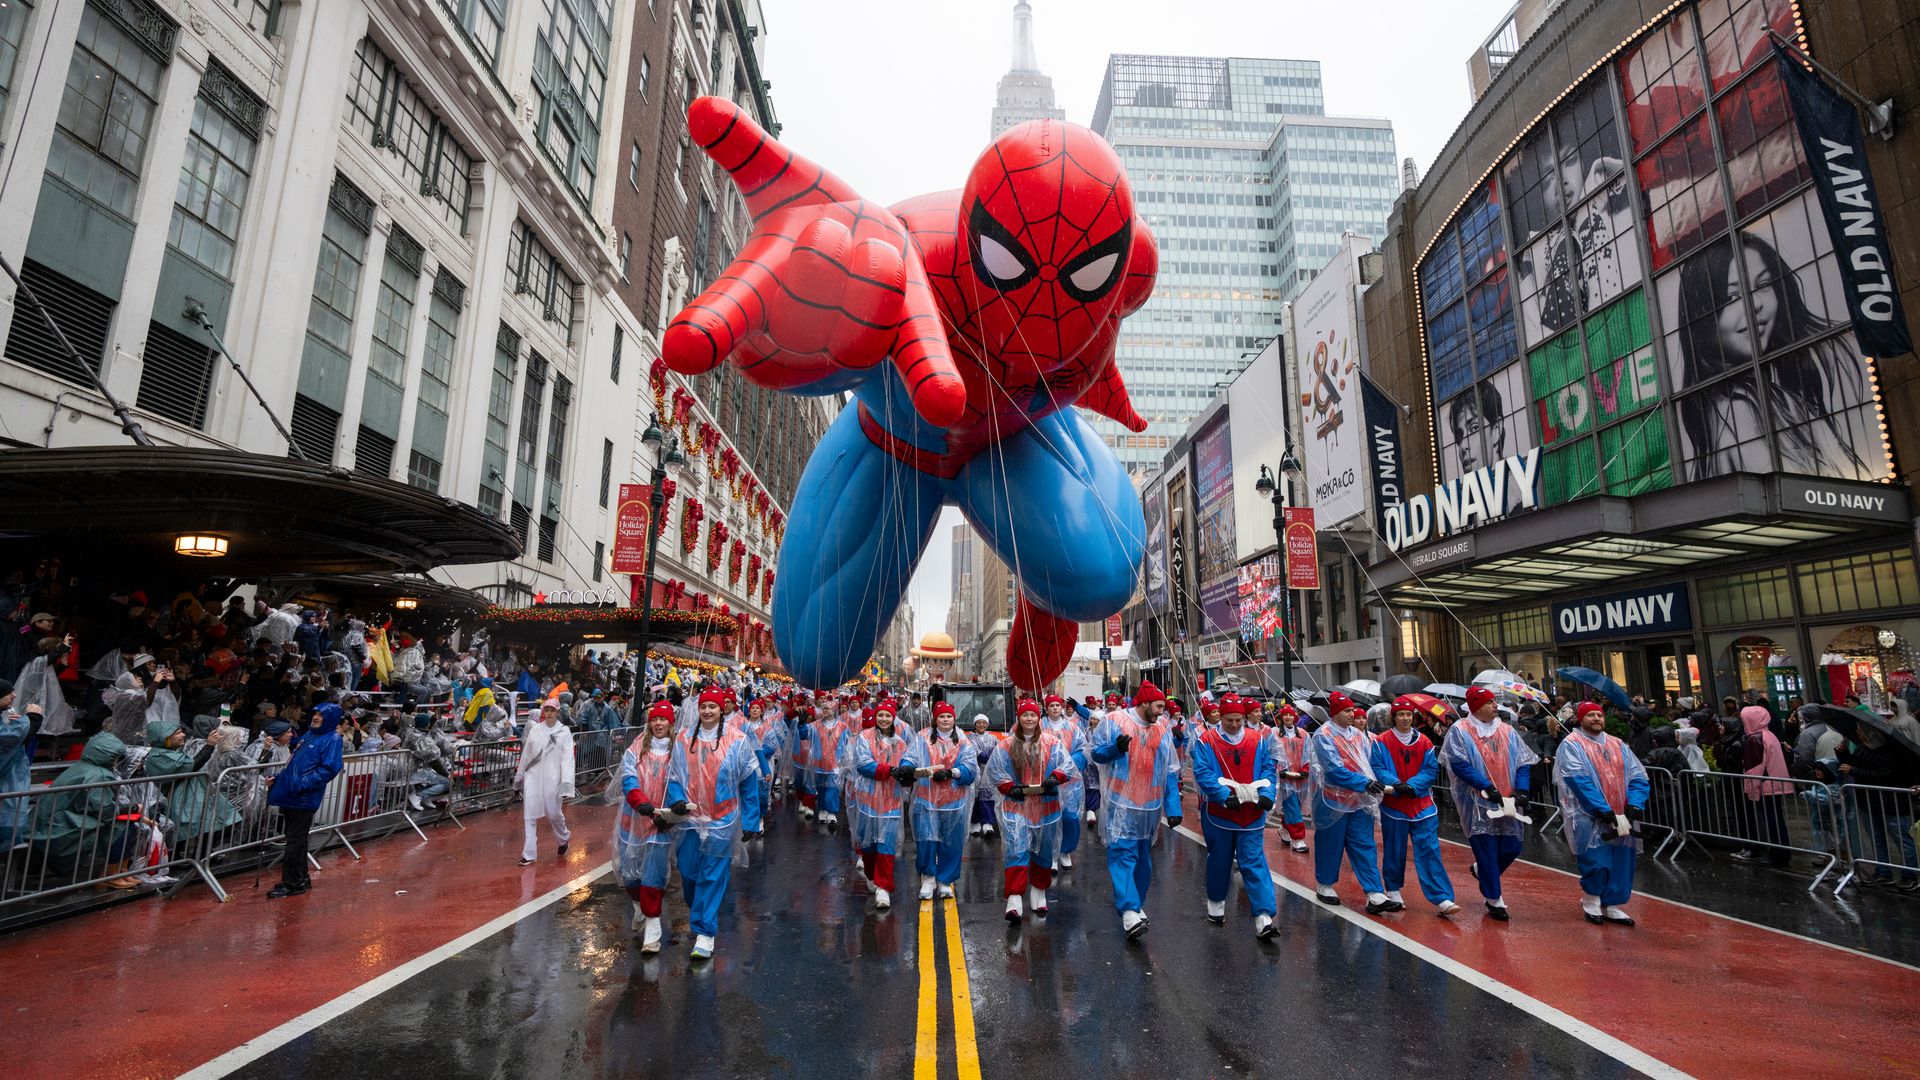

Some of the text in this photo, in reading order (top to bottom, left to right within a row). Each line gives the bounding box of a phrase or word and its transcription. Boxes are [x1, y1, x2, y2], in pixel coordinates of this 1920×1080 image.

[1819, 136, 1893, 321] OLD NAVY
[1537, 345, 1657, 445] LOVE
[1374, 425, 1397, 479] NAVY
[1385, 446, 1541, 553] OLD NAVY
[1804, 489, 1884, 511] OLD NAVY
[619, 520, 645, 530] Holiday
[619, 527, 644, 537] Square
[1172, 536, 1182, 575] KAY
[1290, 541, 1313, 550] Holiday
[1290, 548, 1313, 556] Square
[1412, 541, 1469, 567] HERALD SQUARE
[549, 585, 616, 608] macy's
[1560, 592, 1674, 634] OLD NAVY
